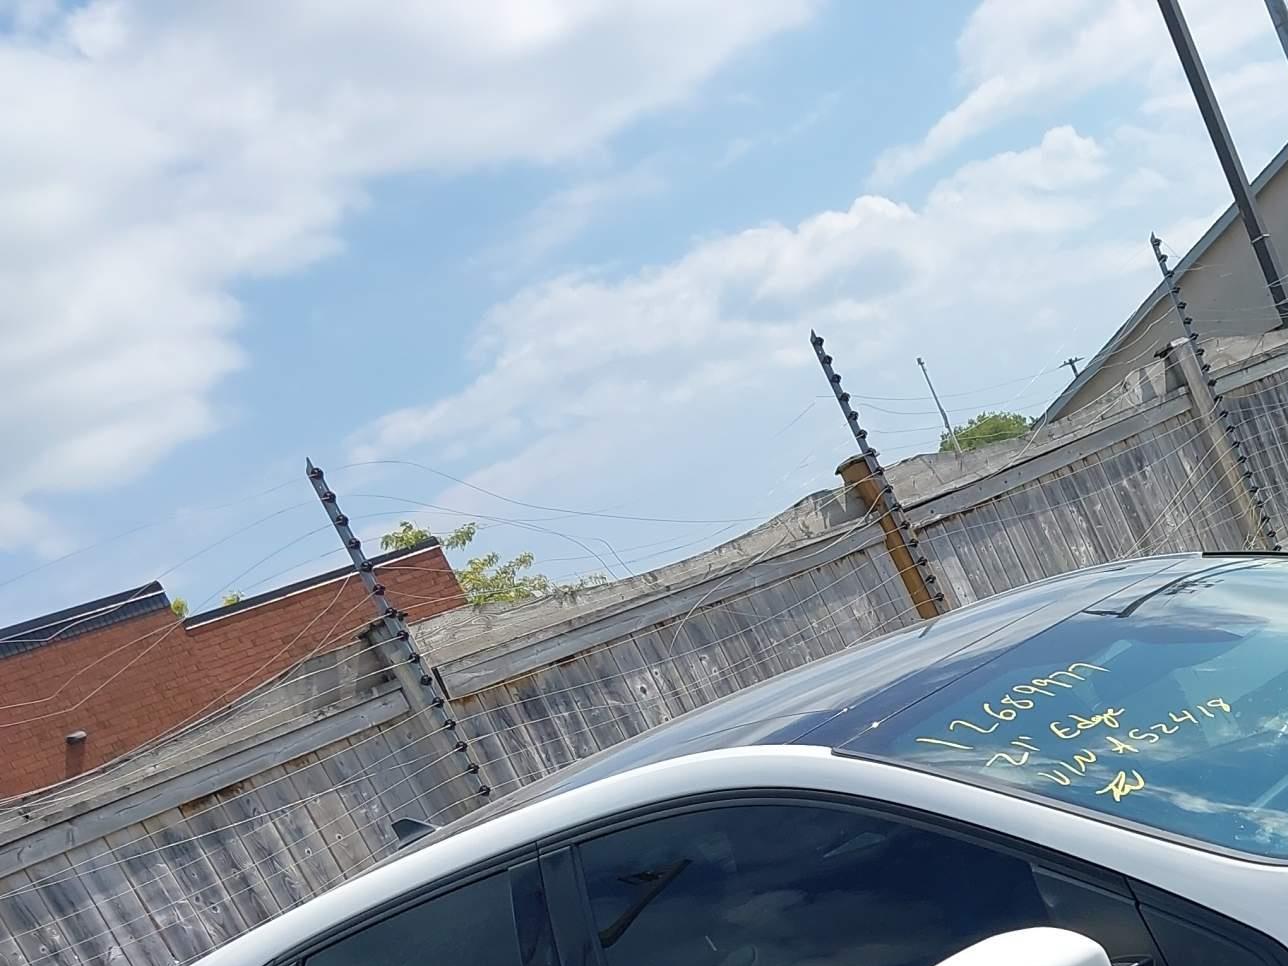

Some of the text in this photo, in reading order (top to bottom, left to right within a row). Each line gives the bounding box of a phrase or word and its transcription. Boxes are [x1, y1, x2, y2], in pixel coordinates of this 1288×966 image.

[914, 662, 1111, 751] 12689977
[1049, 708, 1125, 739] Edge
[1037, 748, 1097, 786] VIN
